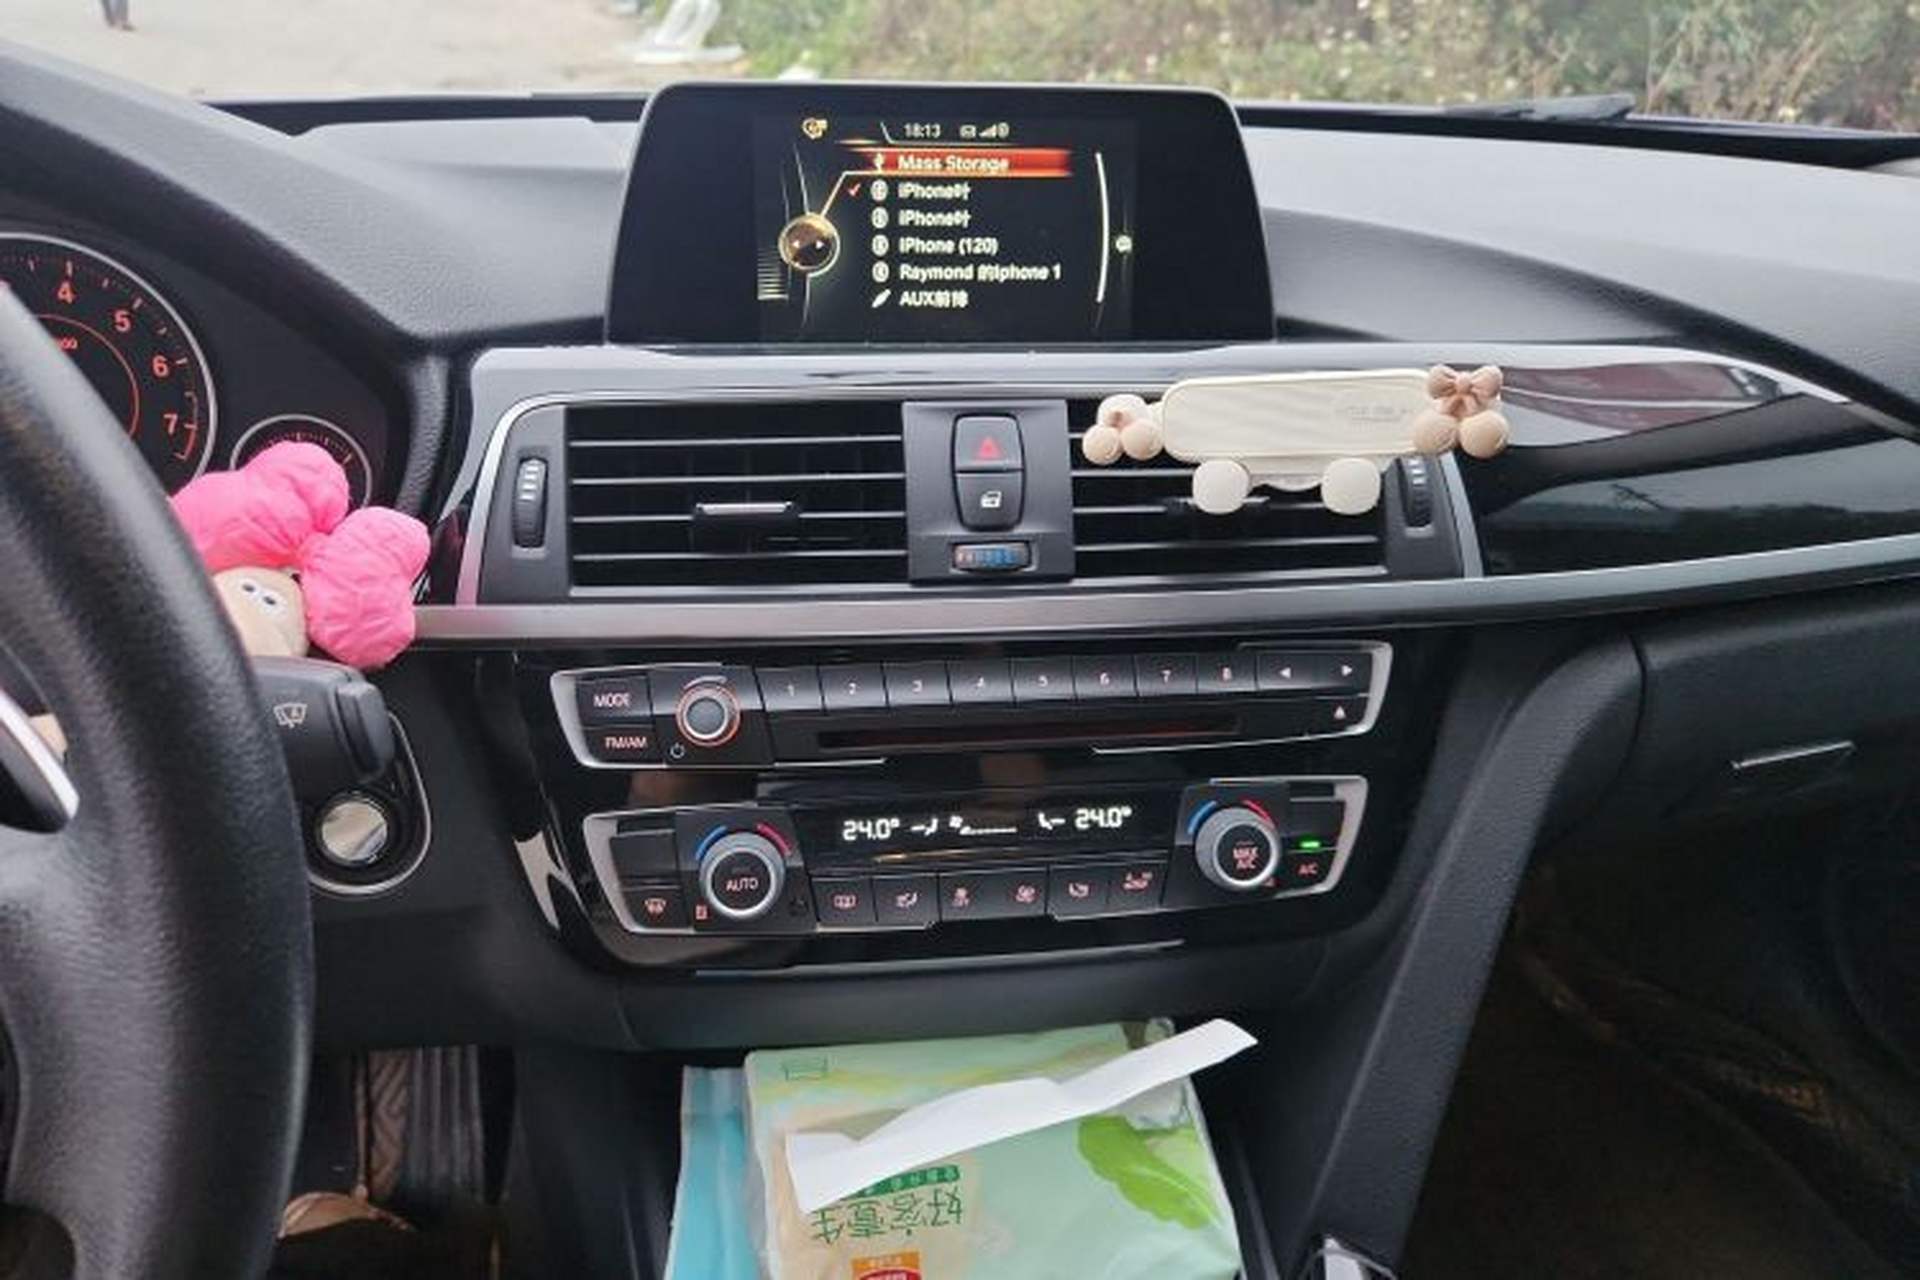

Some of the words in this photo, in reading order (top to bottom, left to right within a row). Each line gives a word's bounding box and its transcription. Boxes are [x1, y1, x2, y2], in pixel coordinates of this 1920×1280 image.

[904, 123, 941, 139] 18:13
[898, 154, 943, 171] Mass
[945, 154, 1009, 174] Storage
[899, 236, 955, 254] iPhone
[958, 236, 999, 256] (120)
[899, 264, 974, 284] Raymond
[1052, 263, 1062, 281] 1
[57, 280, 77, 305] 4
[113, 310, 132, 333] 5
[152, 354, 170, 378] 6
[163, 413, 179, 436] 7
[911, 679, 923, 694] 3
[1099, 671, 1110, 686] 6
[1161, 669, 1172, 684] 7
[725, 876, 759, 892] AUTO
